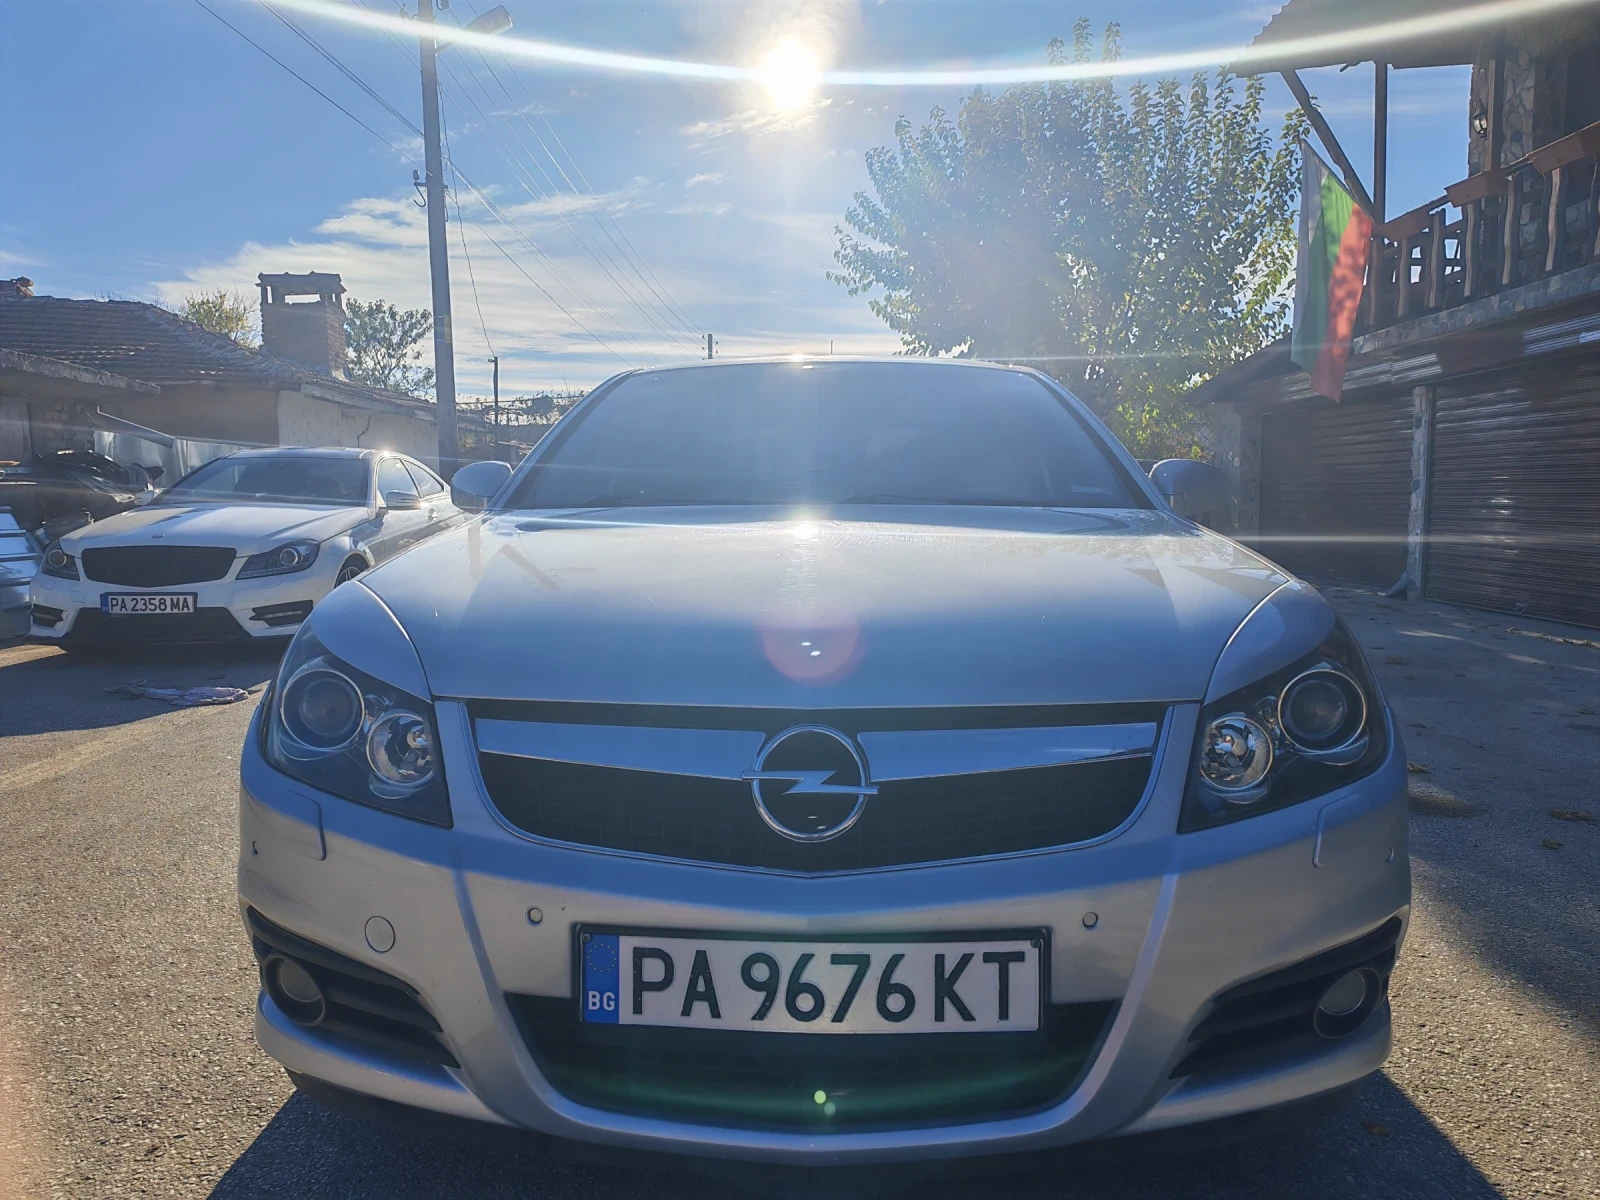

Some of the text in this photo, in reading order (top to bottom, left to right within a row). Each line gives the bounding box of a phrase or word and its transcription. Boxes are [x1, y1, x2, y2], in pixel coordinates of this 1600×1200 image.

[110, 597, 191, 612] PA 2358 MA
[631, 946, 1026, 1023] PA 9676 KT
[588, 990, 616, 1011] BG
